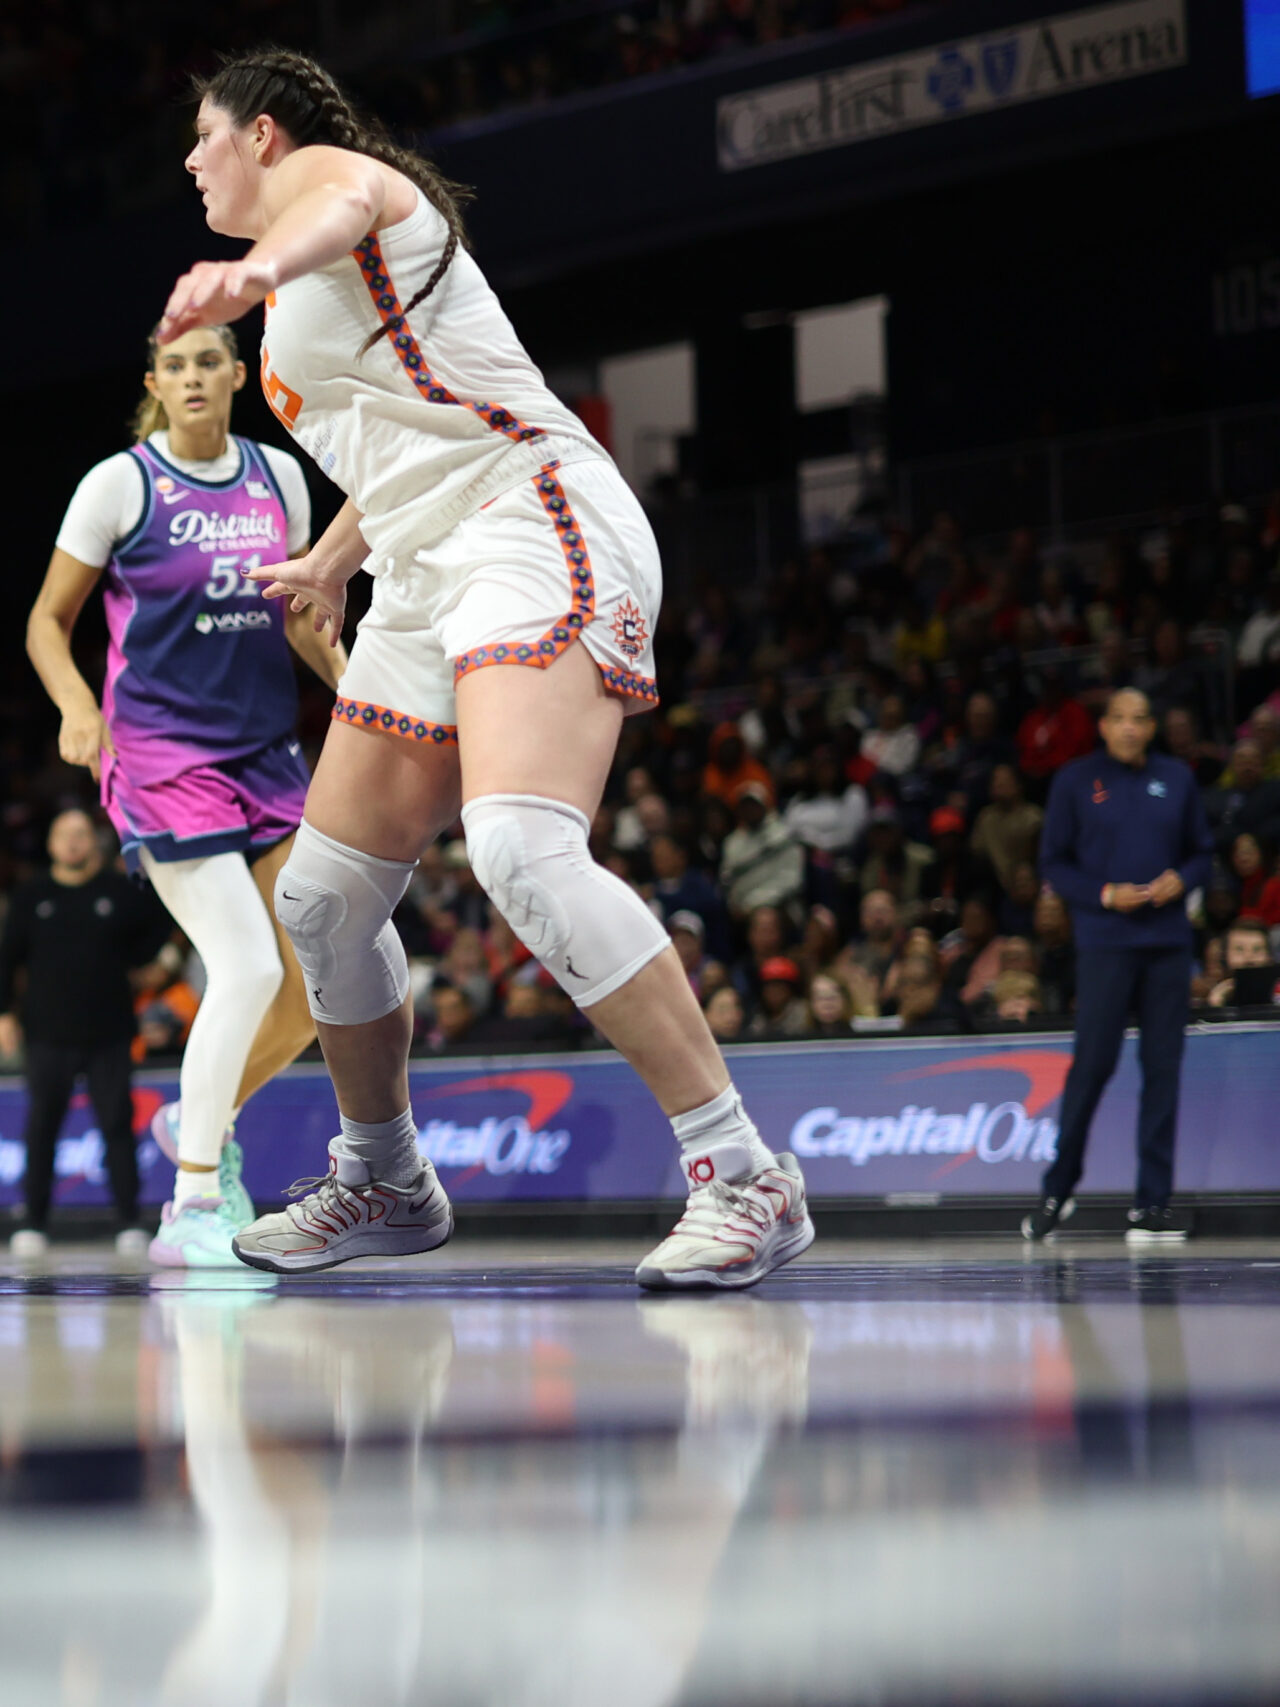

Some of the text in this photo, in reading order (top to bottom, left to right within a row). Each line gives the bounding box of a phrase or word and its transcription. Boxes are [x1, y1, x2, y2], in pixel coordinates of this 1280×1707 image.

[1027, 20, 1180, 88] Arena
[168, 507, 281, 546] District
[205, 553, 262, 599] 51
[212, 610, 272, 628] VANDA
